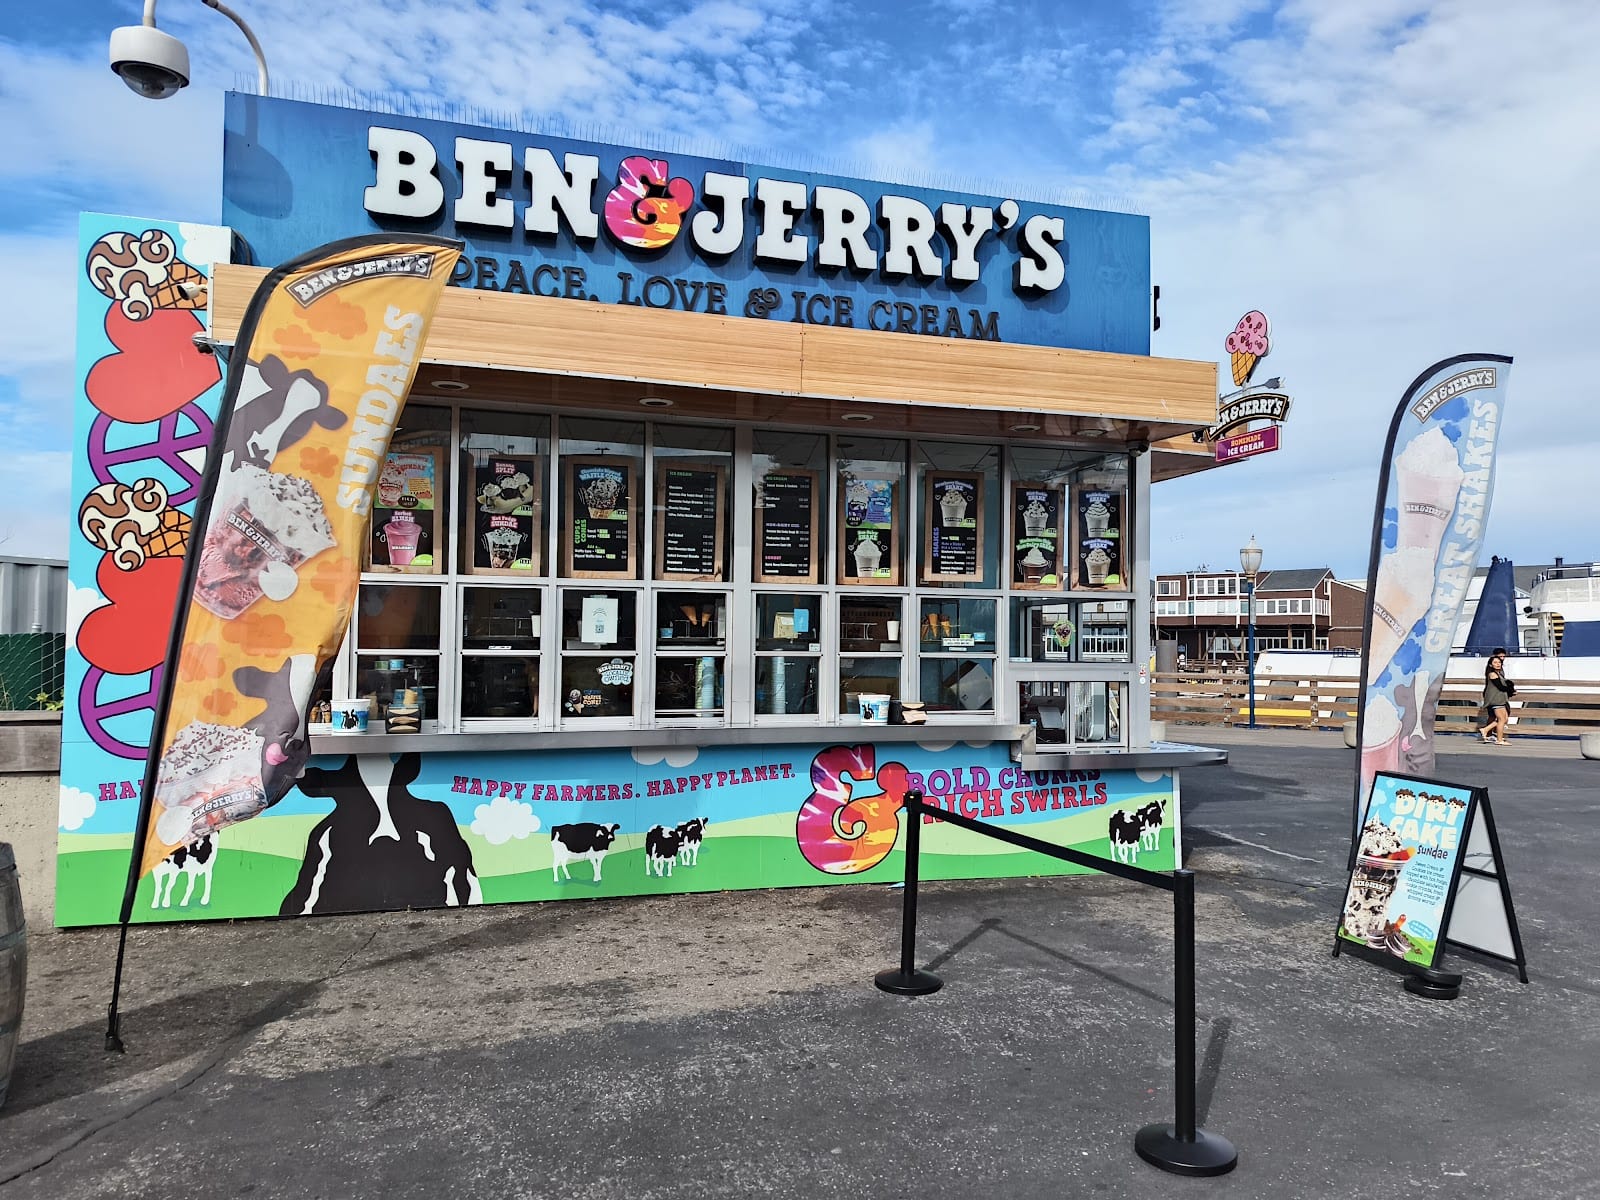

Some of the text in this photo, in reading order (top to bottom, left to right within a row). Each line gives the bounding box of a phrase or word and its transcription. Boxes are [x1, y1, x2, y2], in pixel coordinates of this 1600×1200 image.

[617, 272, 728, 315] LOVE
[744, 287, 783, 319] &
[791, 290, 855, 328] ICE
[868, 300, 1001, 341] CREAM
[337, 304, 424, 515] SUNDAES
[1227, 441, 1265, 457] ICE CREAM
[1454, 399, 1498, 541] SHAKES
[451, 775, 641, 801] HAPPY FARMERS.
[646, 763, 796, 797] HAPPY PLANET.
[905, 766, 990, 796] BOLD
[1010, 783, 1107, 814] SWIRLS
[1395, 788, 1467, 826] DIRT
[1389, 815, 1458, 849] CAKE
